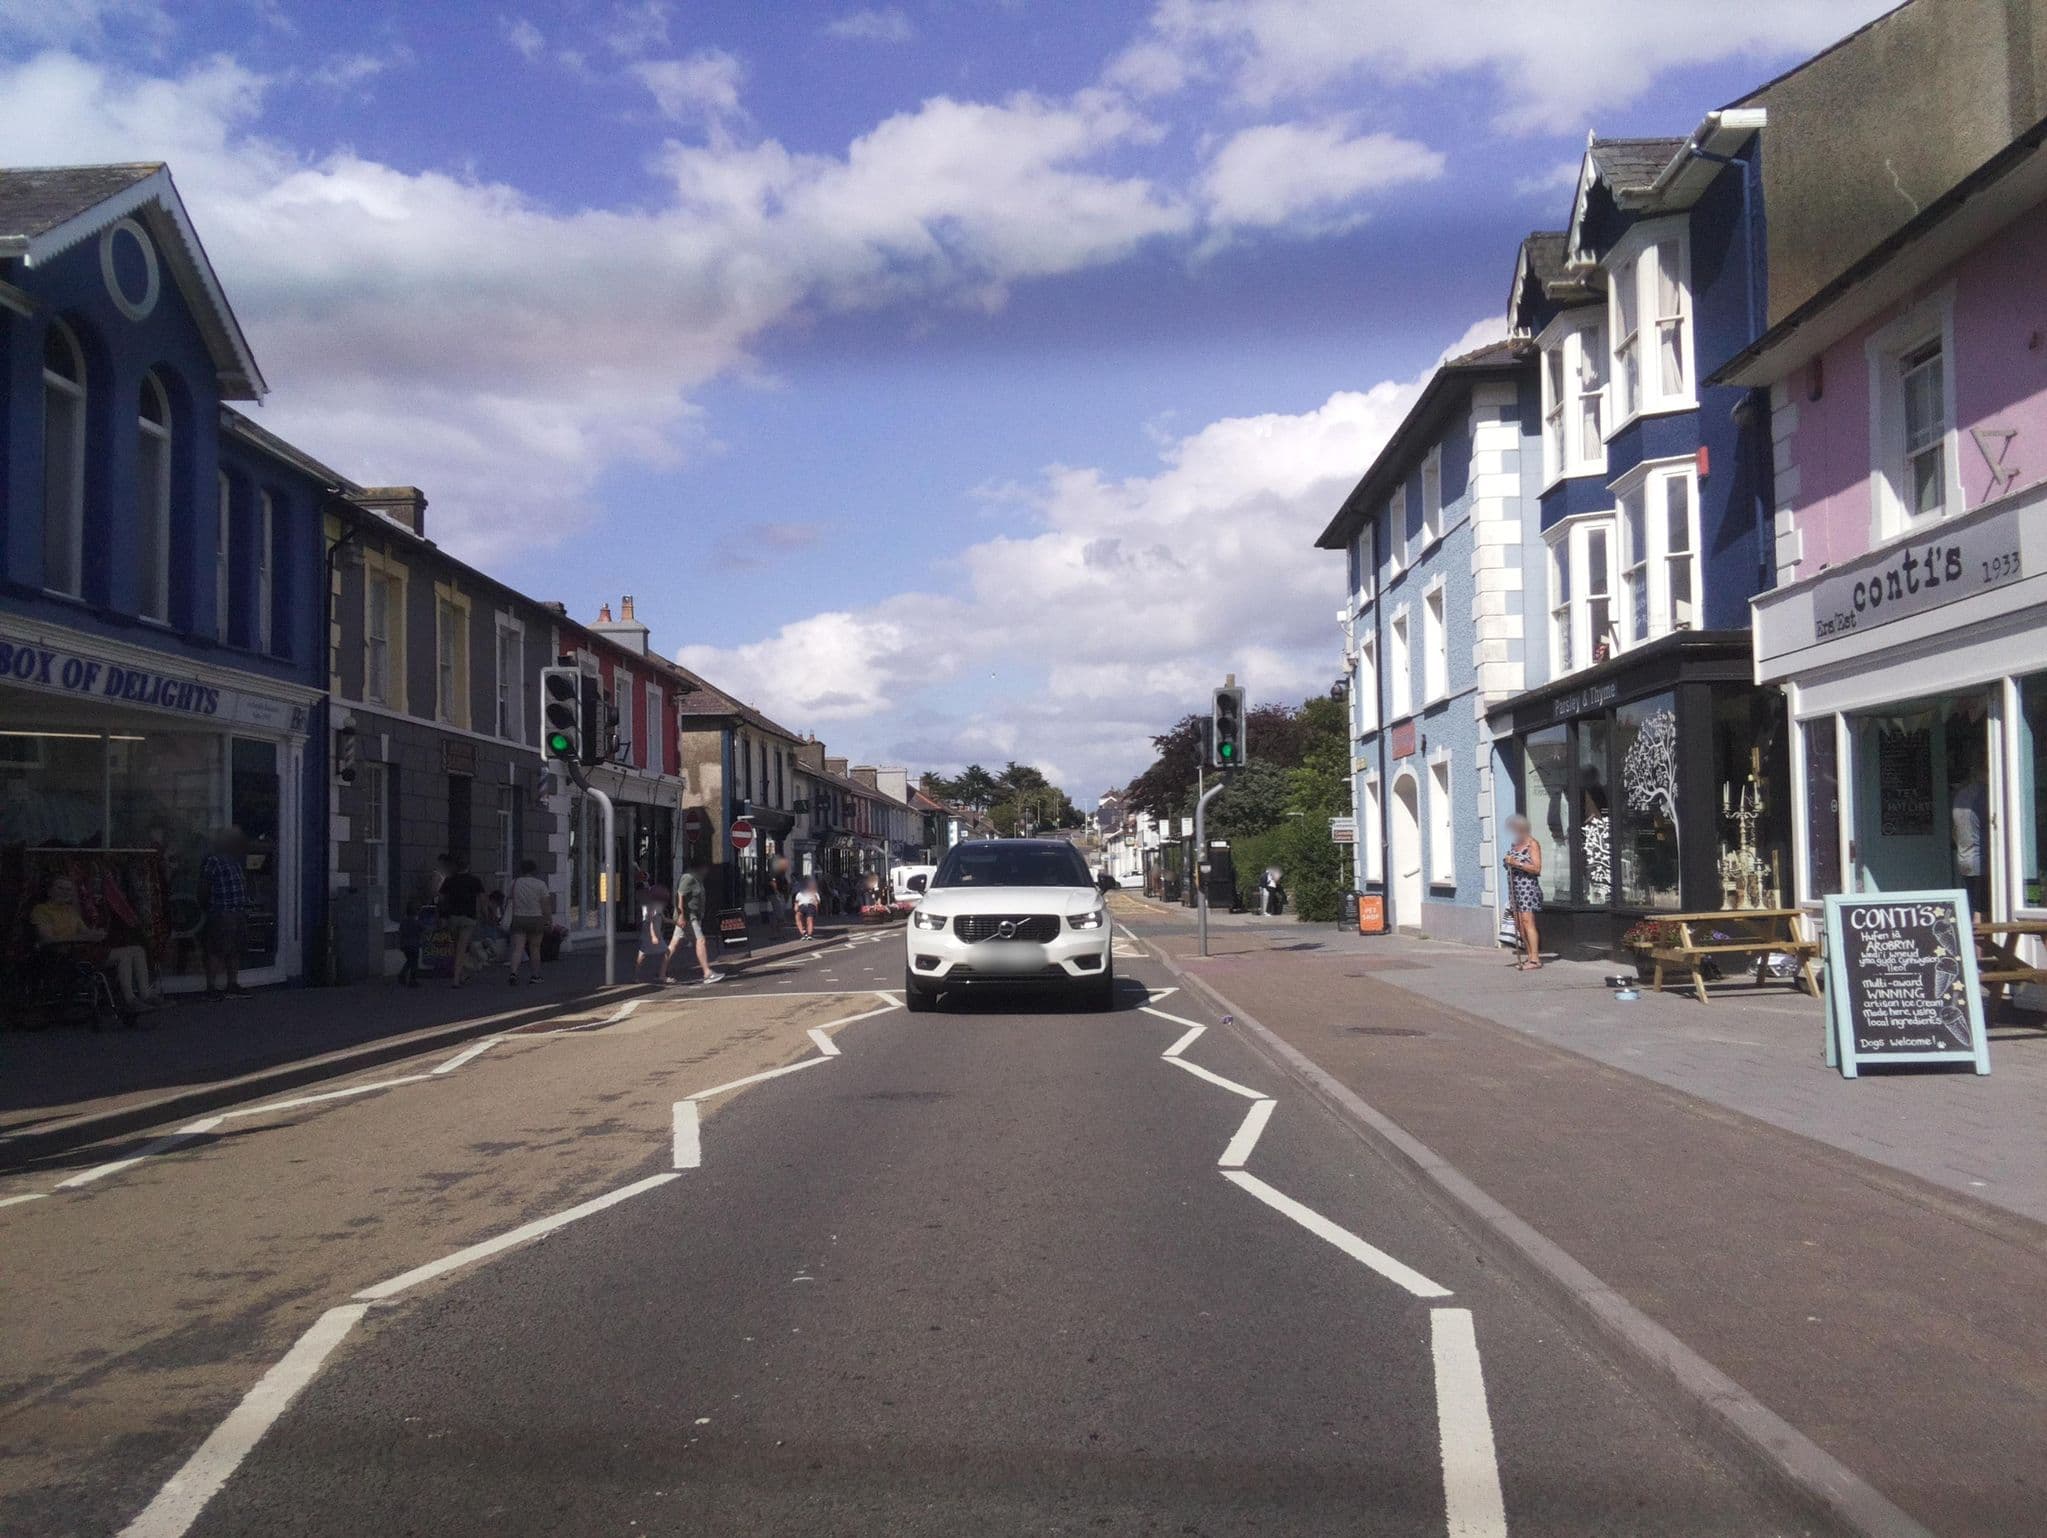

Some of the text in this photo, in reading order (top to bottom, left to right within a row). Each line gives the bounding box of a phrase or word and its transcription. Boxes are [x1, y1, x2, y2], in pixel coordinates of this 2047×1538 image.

[1853, 545, 1962, 612] conti's
[1982, 551, 2020, 583] 1933
[63, 658, 102, 691] OF
[104, 666, 219, 714] DELIGHTS
[1851, 904, 1936, 929] CONTI'S
[1866, 988, 1925, 999] WINNING
[1867, 1017, 1943, 1028] local ingredients
[1860, 1038, 1885, 1050] Dogs
